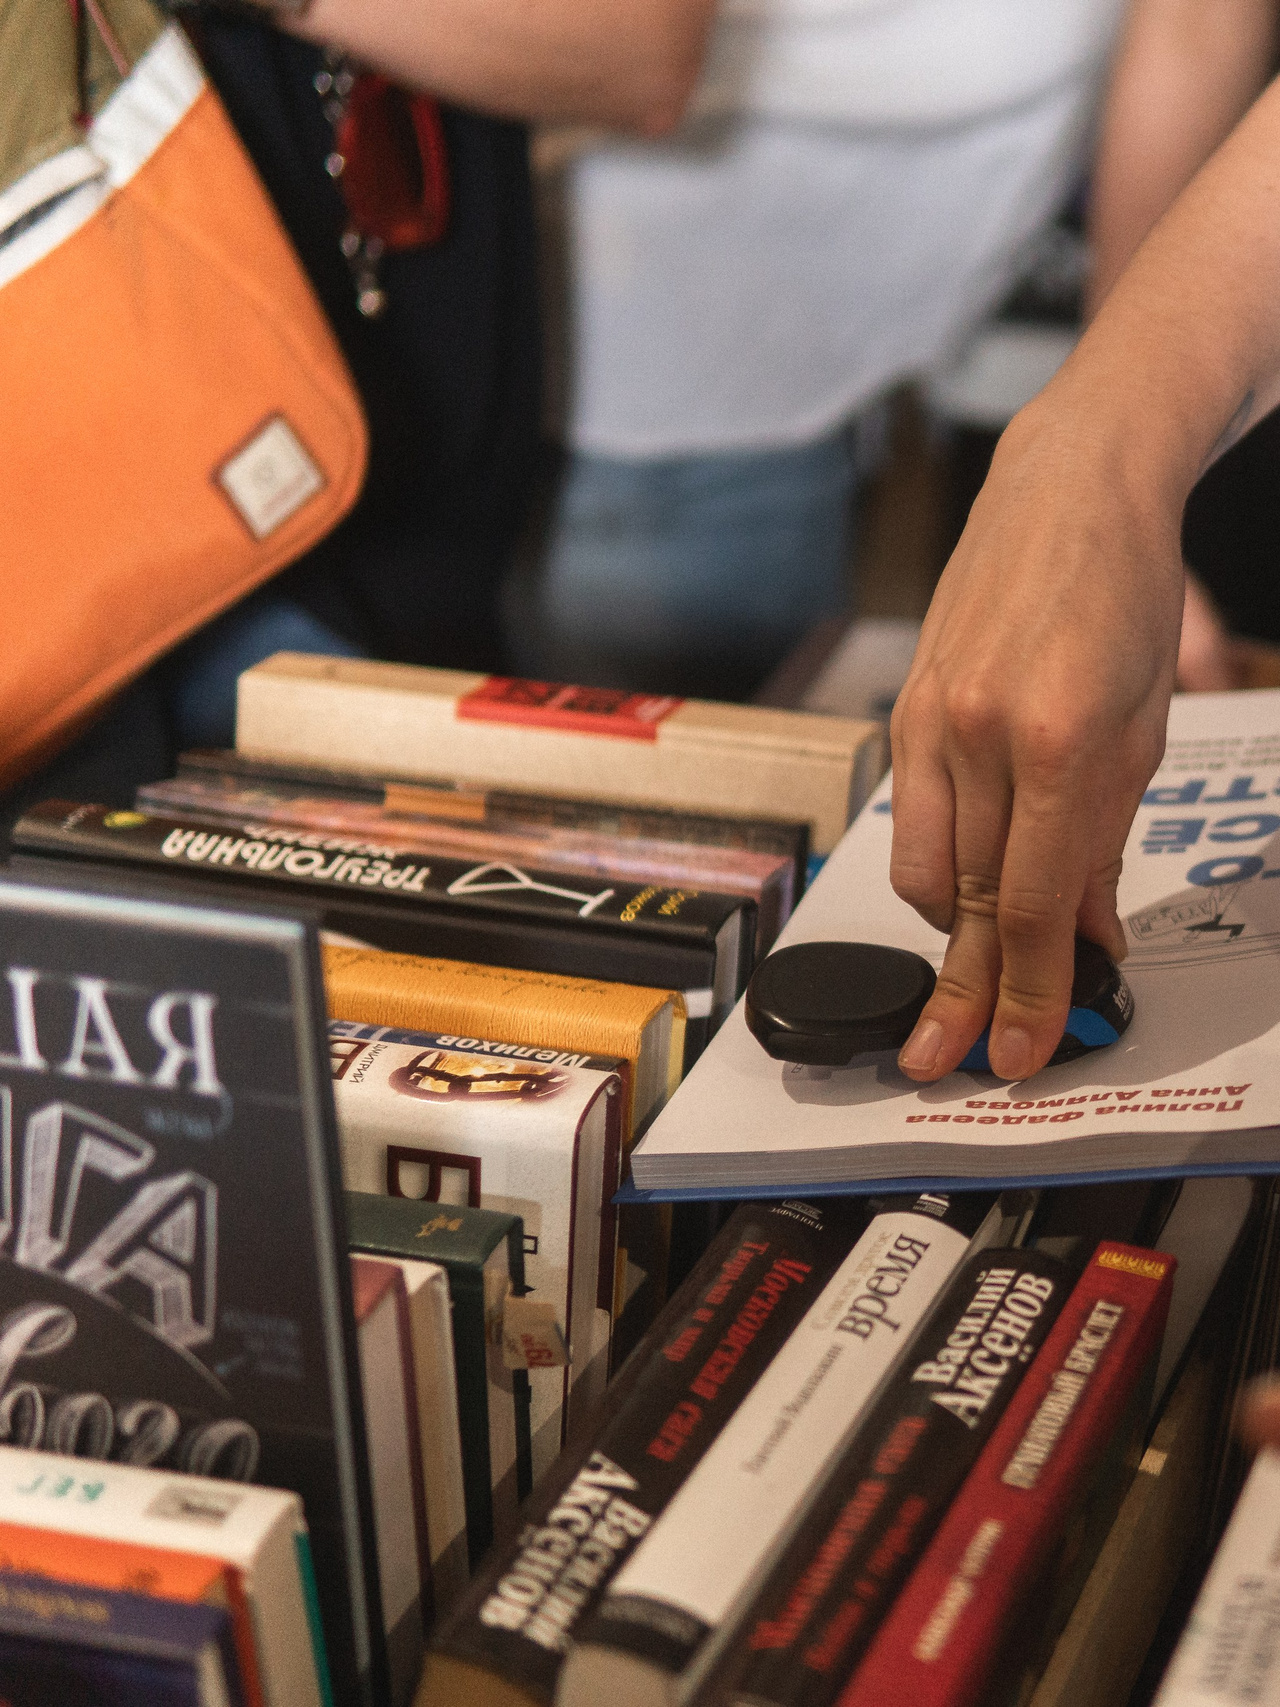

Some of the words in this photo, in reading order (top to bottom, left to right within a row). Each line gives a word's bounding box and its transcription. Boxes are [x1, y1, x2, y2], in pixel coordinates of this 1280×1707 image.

[162, 827, 430, 893] ТРЕУГОЛЬНАЯ
[436, 1033, 591, 1069] Мелихов
[905, 1107, 1083, 1127] Фадеева
[966, 1089, 1142, 1112] Алямова
[1096, 1099, 1244, 1117] Полина
[1153, 1084, 1251, 1101] Анна
[840, 1232, 930, 1342] время
[688, 1257, 812, 1402] Московская
[912, 1265, 1014, 1389] Василий
[930, 1271, 1055, 1430] Аксёнов
[1072, 1300, 1124, 1378] БРАСЛЕТ
[480, 1450, 639, 1625] Аксёнов
[524, 1500, 653, 1649] Василий
